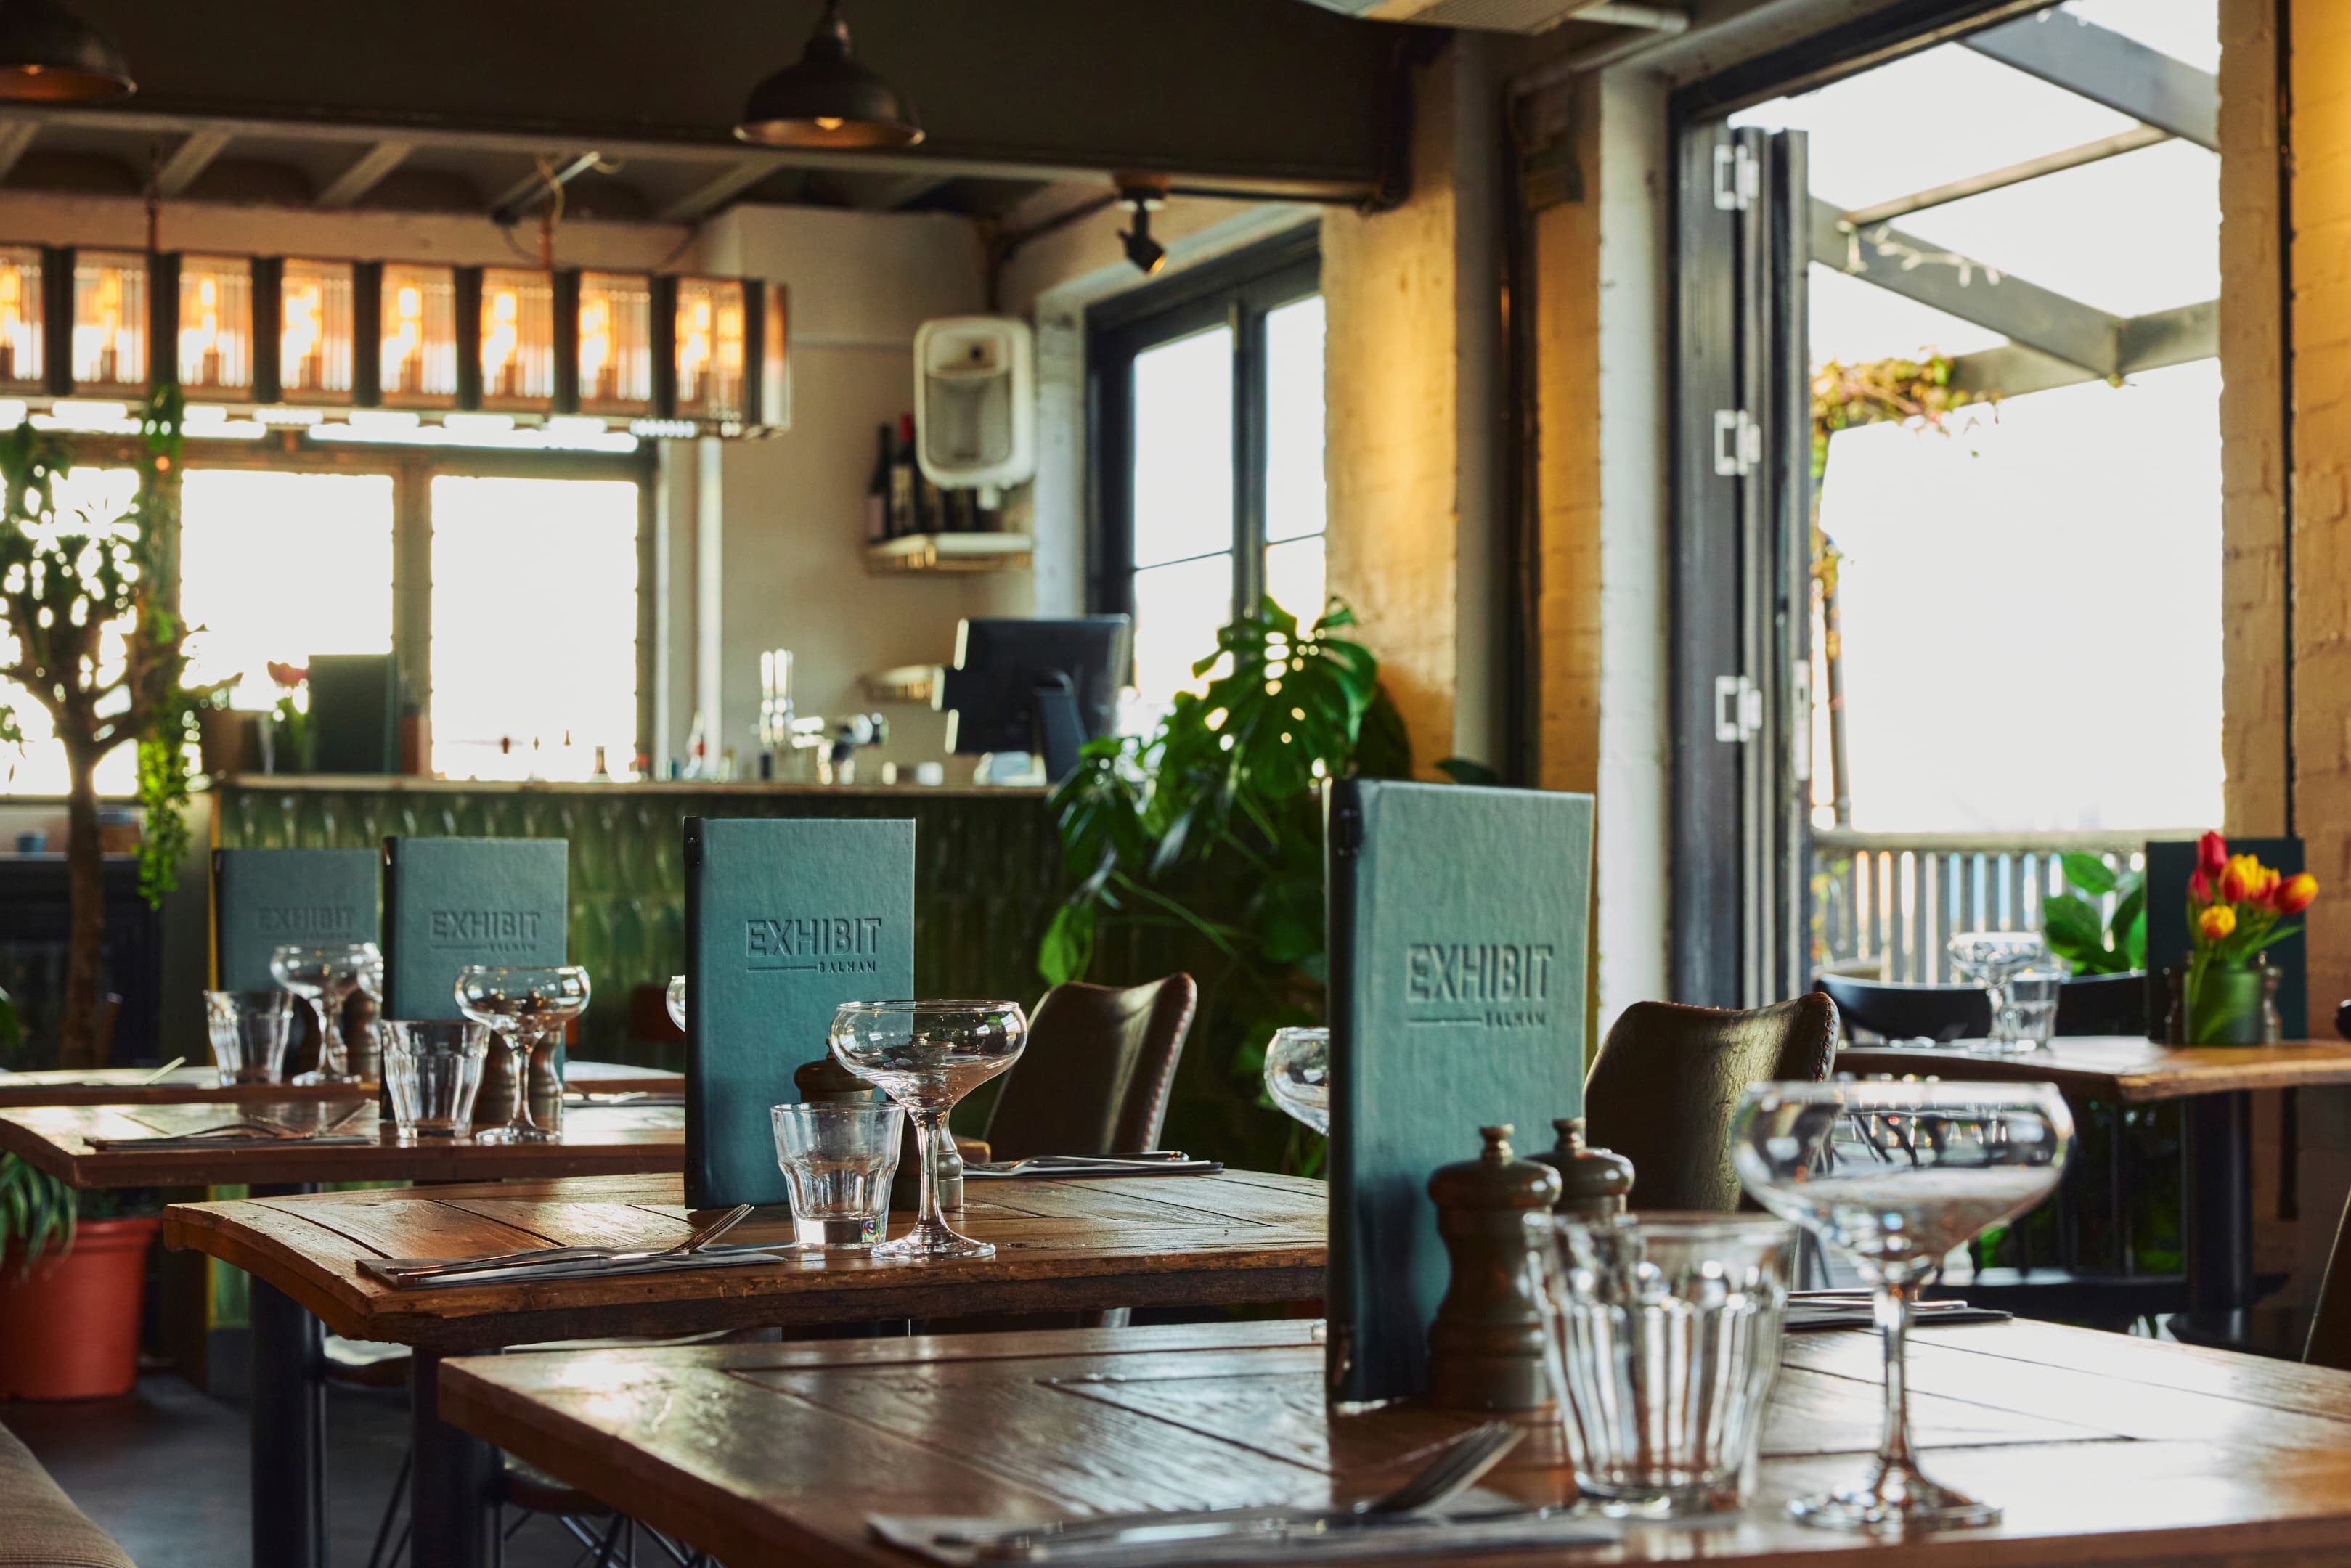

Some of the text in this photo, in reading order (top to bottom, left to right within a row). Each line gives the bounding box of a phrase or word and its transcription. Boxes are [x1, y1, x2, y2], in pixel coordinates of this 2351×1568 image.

[431, 911, 541, 940] EXHIBIT
[746, 918, 881, 957] EXHIBIT
[818, 960, 876, 973] BALHAM
[1406, 944, 1554, 1003] EXHIBIT
